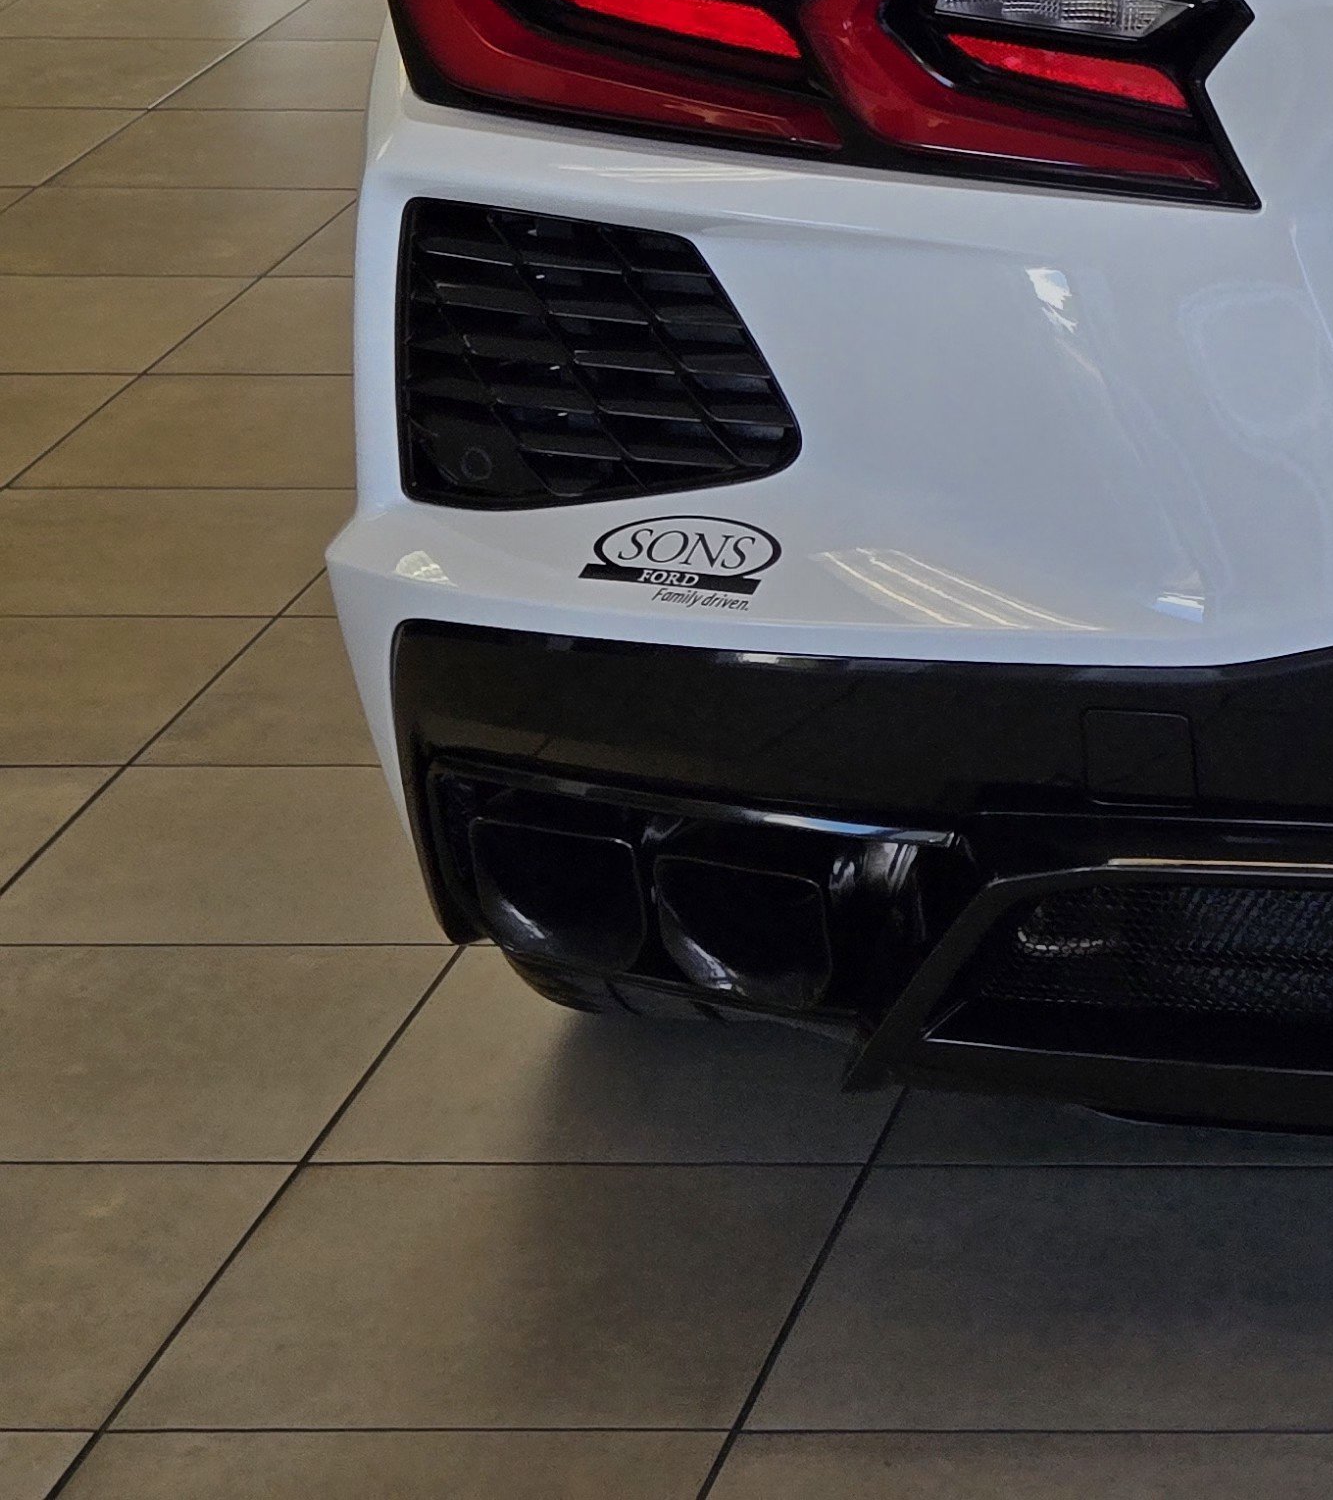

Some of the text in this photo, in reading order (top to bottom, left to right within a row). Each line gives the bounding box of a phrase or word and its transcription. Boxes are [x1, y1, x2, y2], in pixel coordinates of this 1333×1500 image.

[617, 528, 756, 570] SONS
[637, 569, 700, 587] FORD
[651, 588, 749, 611] Family driven.
